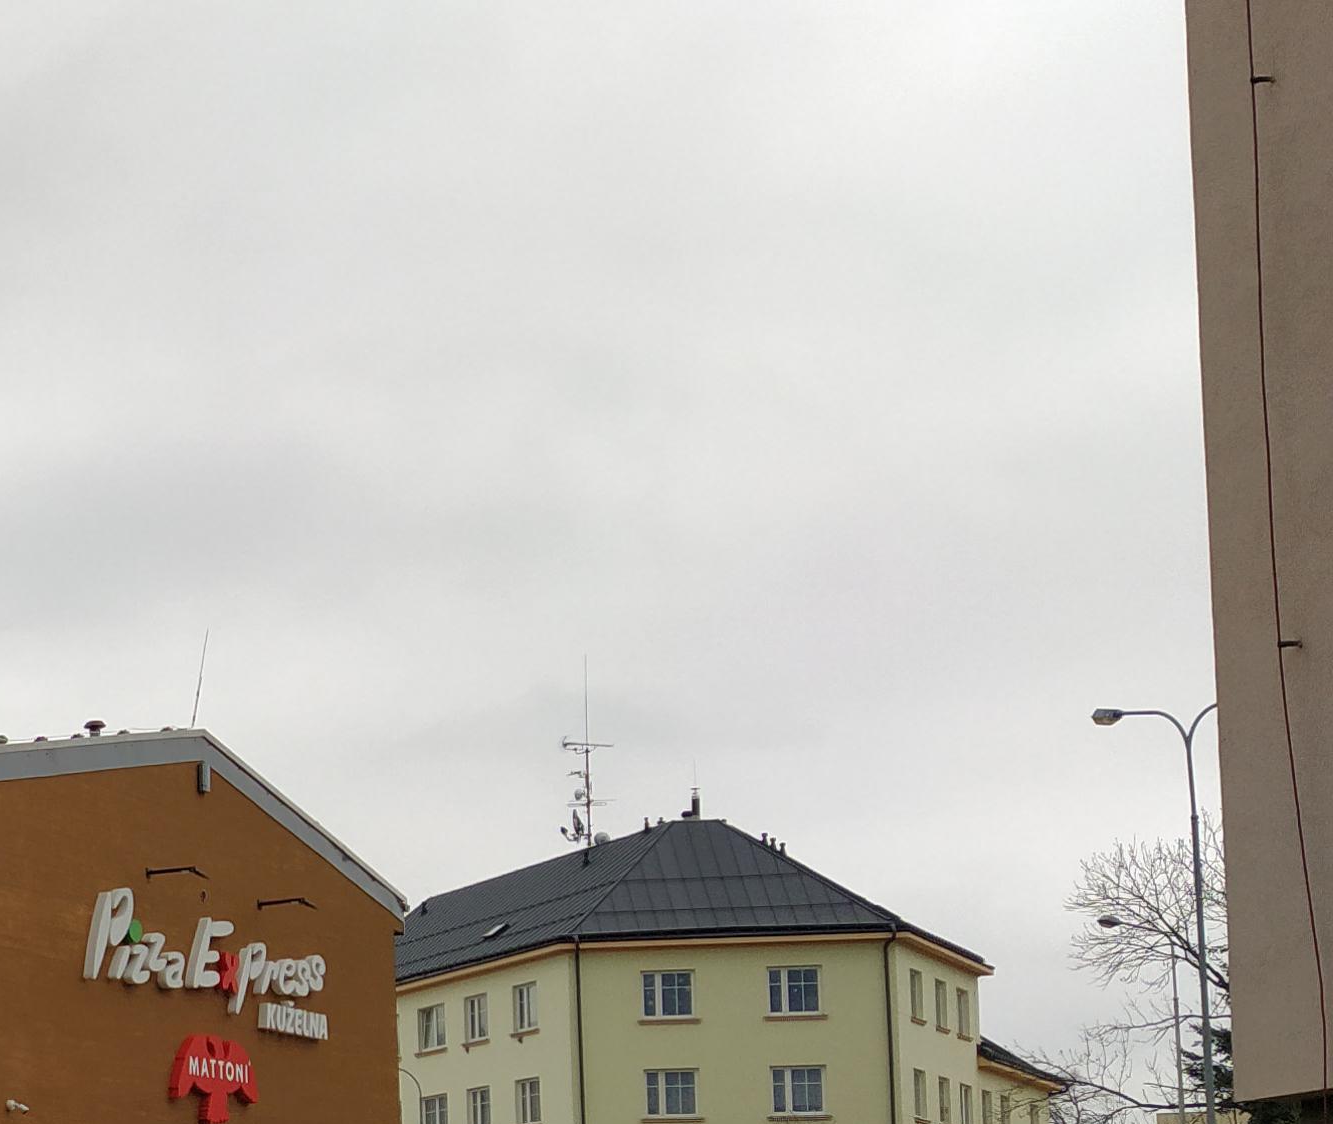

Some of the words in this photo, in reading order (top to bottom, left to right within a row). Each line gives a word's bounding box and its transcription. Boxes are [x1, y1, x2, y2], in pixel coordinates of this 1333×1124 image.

[83, 887, 185, 989] Pizza
[185, 916, 327, 1015] Express
[258, 1000, 330, 1041] KUŽELNA
[187, 1055, 251, 1084] MATTONI
